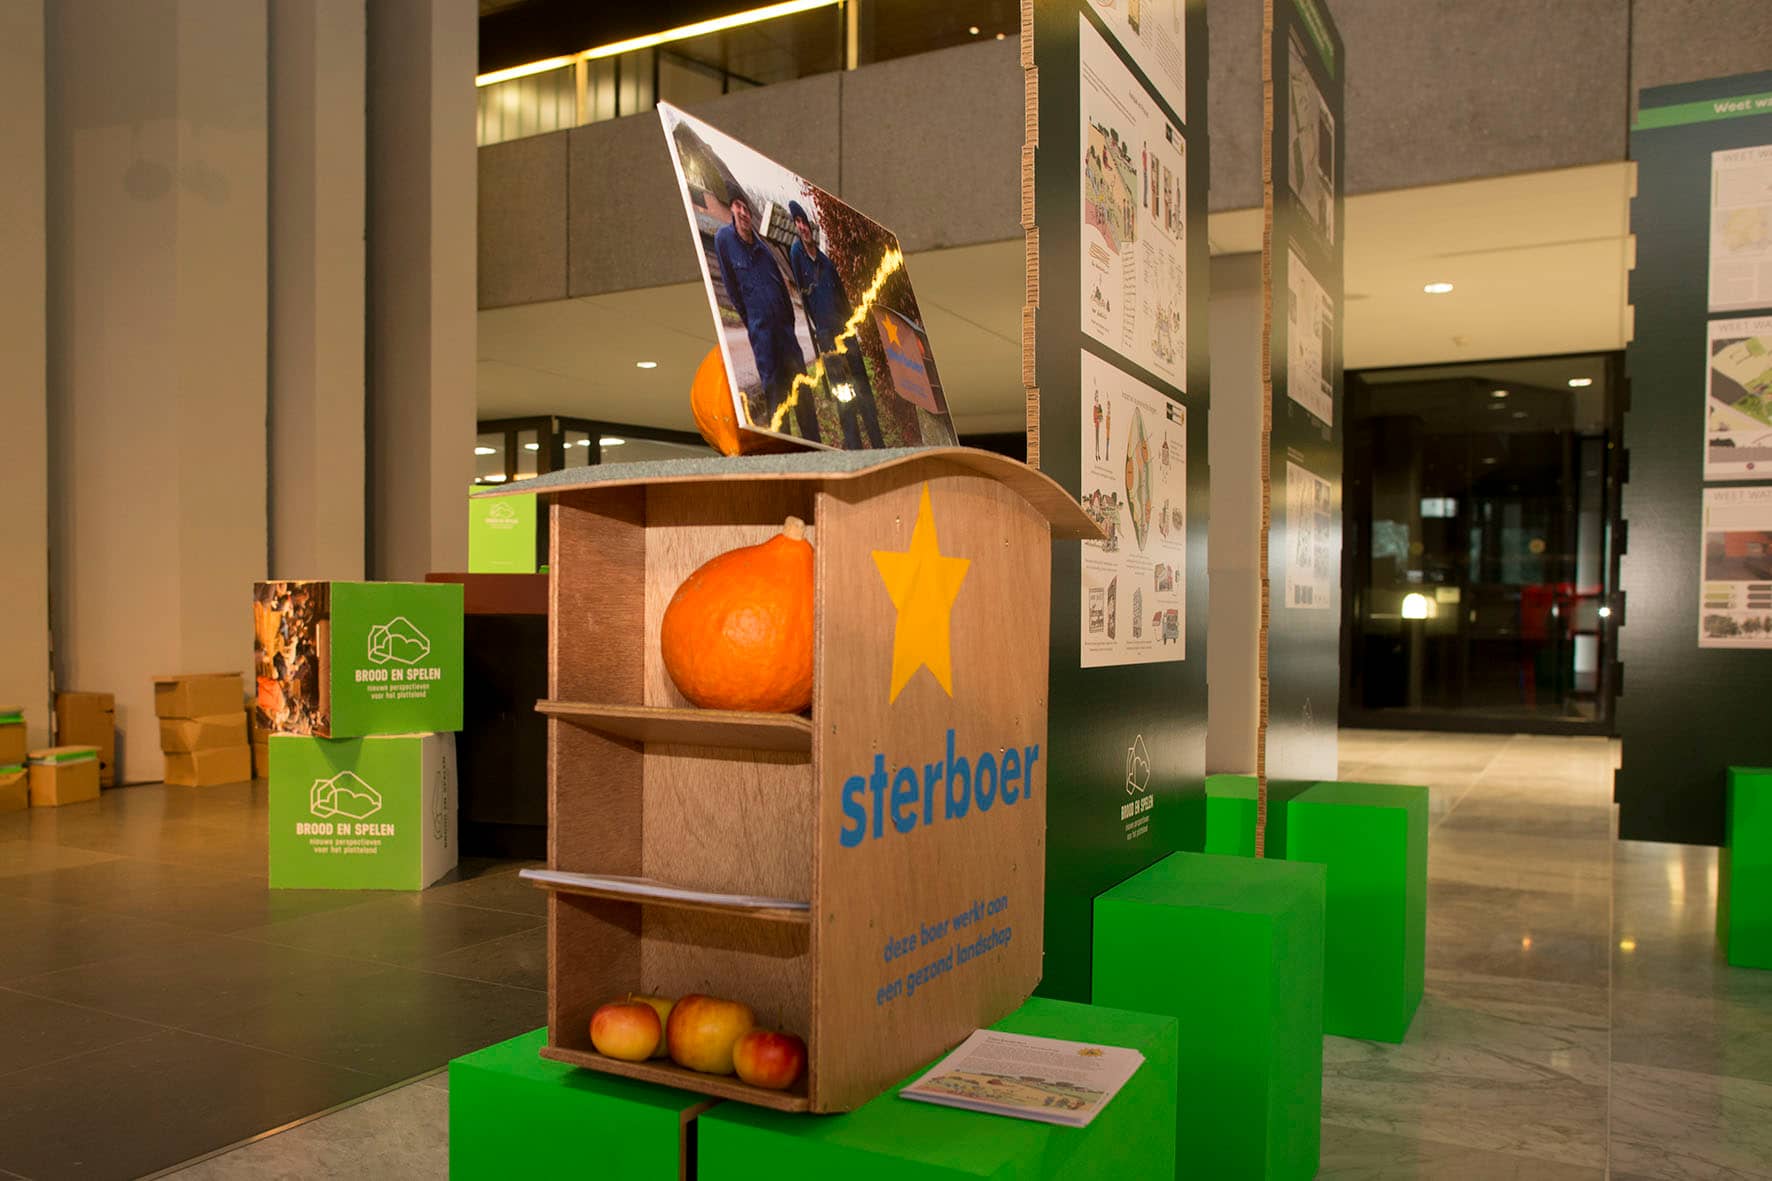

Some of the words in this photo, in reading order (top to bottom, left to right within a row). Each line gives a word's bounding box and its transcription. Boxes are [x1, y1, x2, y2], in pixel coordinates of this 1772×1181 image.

[1714, 100, 1752, 112] Weet
[355, 669, 388, 682] BROOD
[391, 668, 404, 681] EN
[407, 667, 441, 680] SPELEN
[839, 728, 1040, 848] sterboer
[296, 822, 333, 835] BROOD
[337, 823, 351, 836] EN
[354, 823, 395, 836] SPELEN
[883, 936, 917, 963] deze
[920, 919, 949, 946] boer
[952, 898, 985, 931] werkt
[987, 895, 1009, 916] aan
[877, 977, 903, 1006] een
[907, 945, 954, 997] gezond
[956, 926, 1012, 967] landschap
